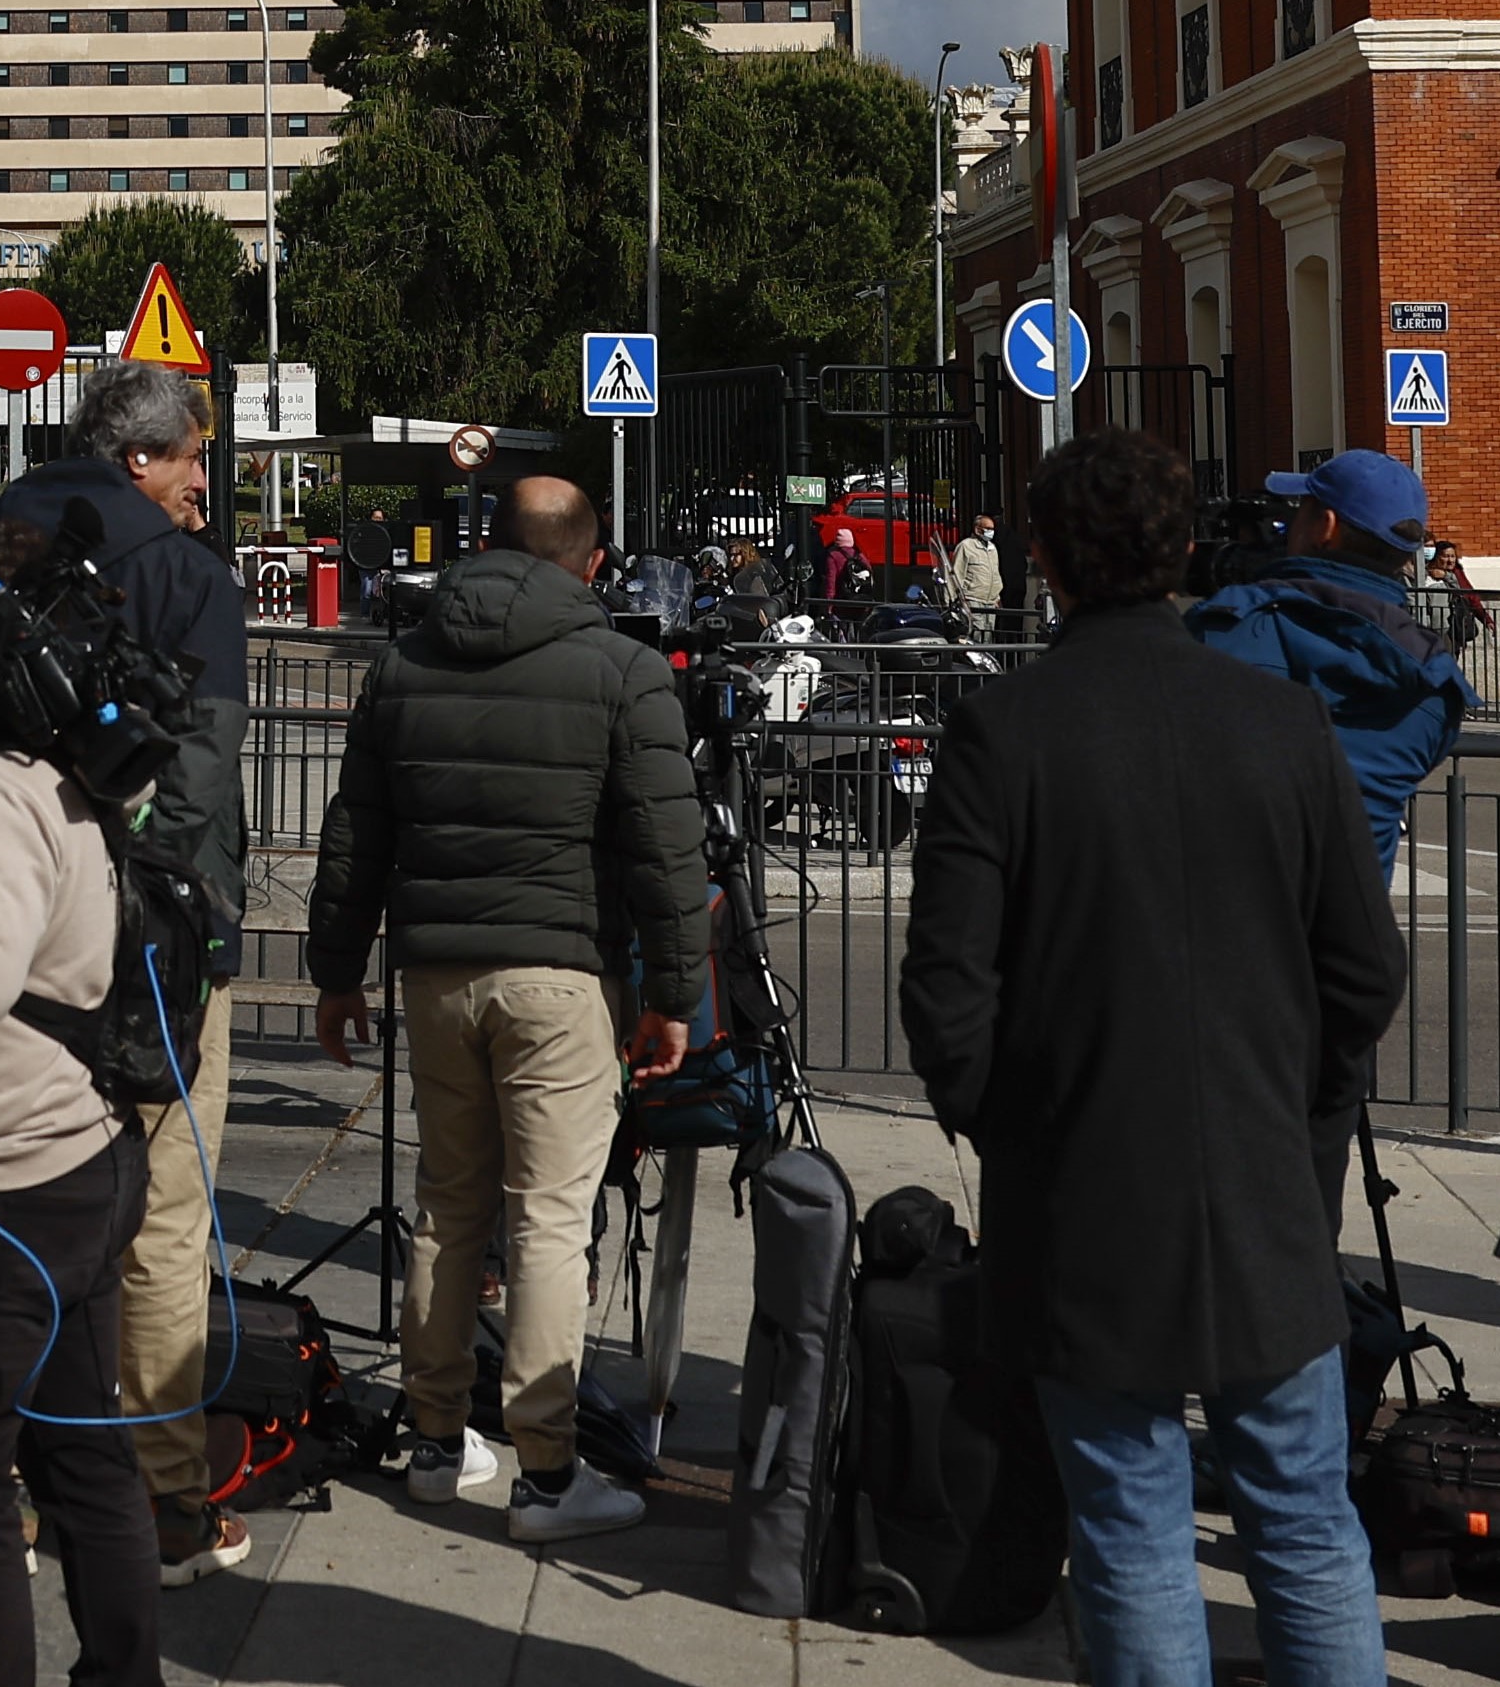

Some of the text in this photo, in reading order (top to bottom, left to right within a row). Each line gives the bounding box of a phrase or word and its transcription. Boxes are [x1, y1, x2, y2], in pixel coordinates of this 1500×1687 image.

[1404, 305, 1443, 313] GLORIETA
[1396, 318, 1442, 329] EJERCITO
[288, 396, 293, 404] a
[295, 393, 303, 404] la
[279, 410, 312, 422] Servicio
[808, 483, 822, 498] NO
